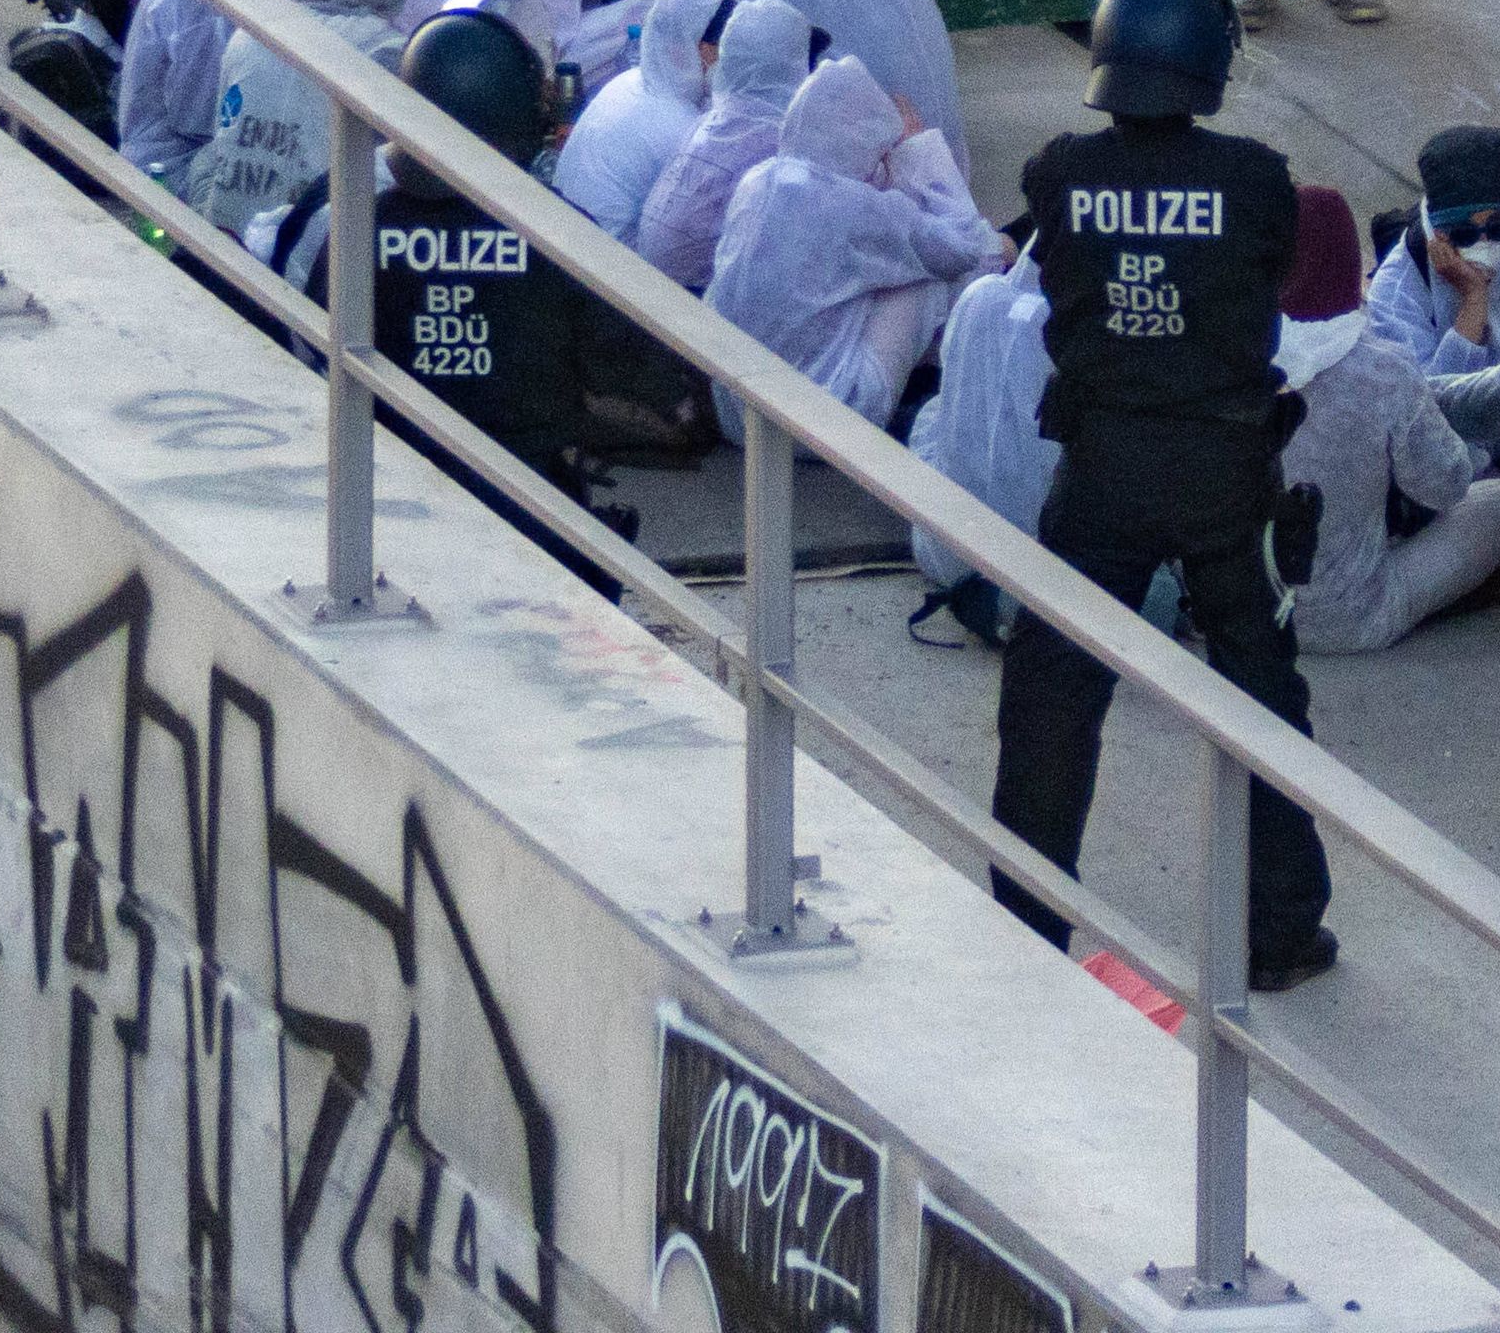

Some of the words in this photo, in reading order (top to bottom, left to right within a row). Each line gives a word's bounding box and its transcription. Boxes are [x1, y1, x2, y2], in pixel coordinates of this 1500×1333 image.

[1071, 189, 1223, 235] POLIZEI
[379, 228, 528, 272] POLIZEI
[1118, 252, 1166, 283] BP
[426, 284, 475, 313] BP
[1106, 281, 1180, 312] BDÜ
[414, 314, 490, 344] BDÜ
[1106, 309, 1186, 337] 4220
[412, 347, 493, 375] 4220
